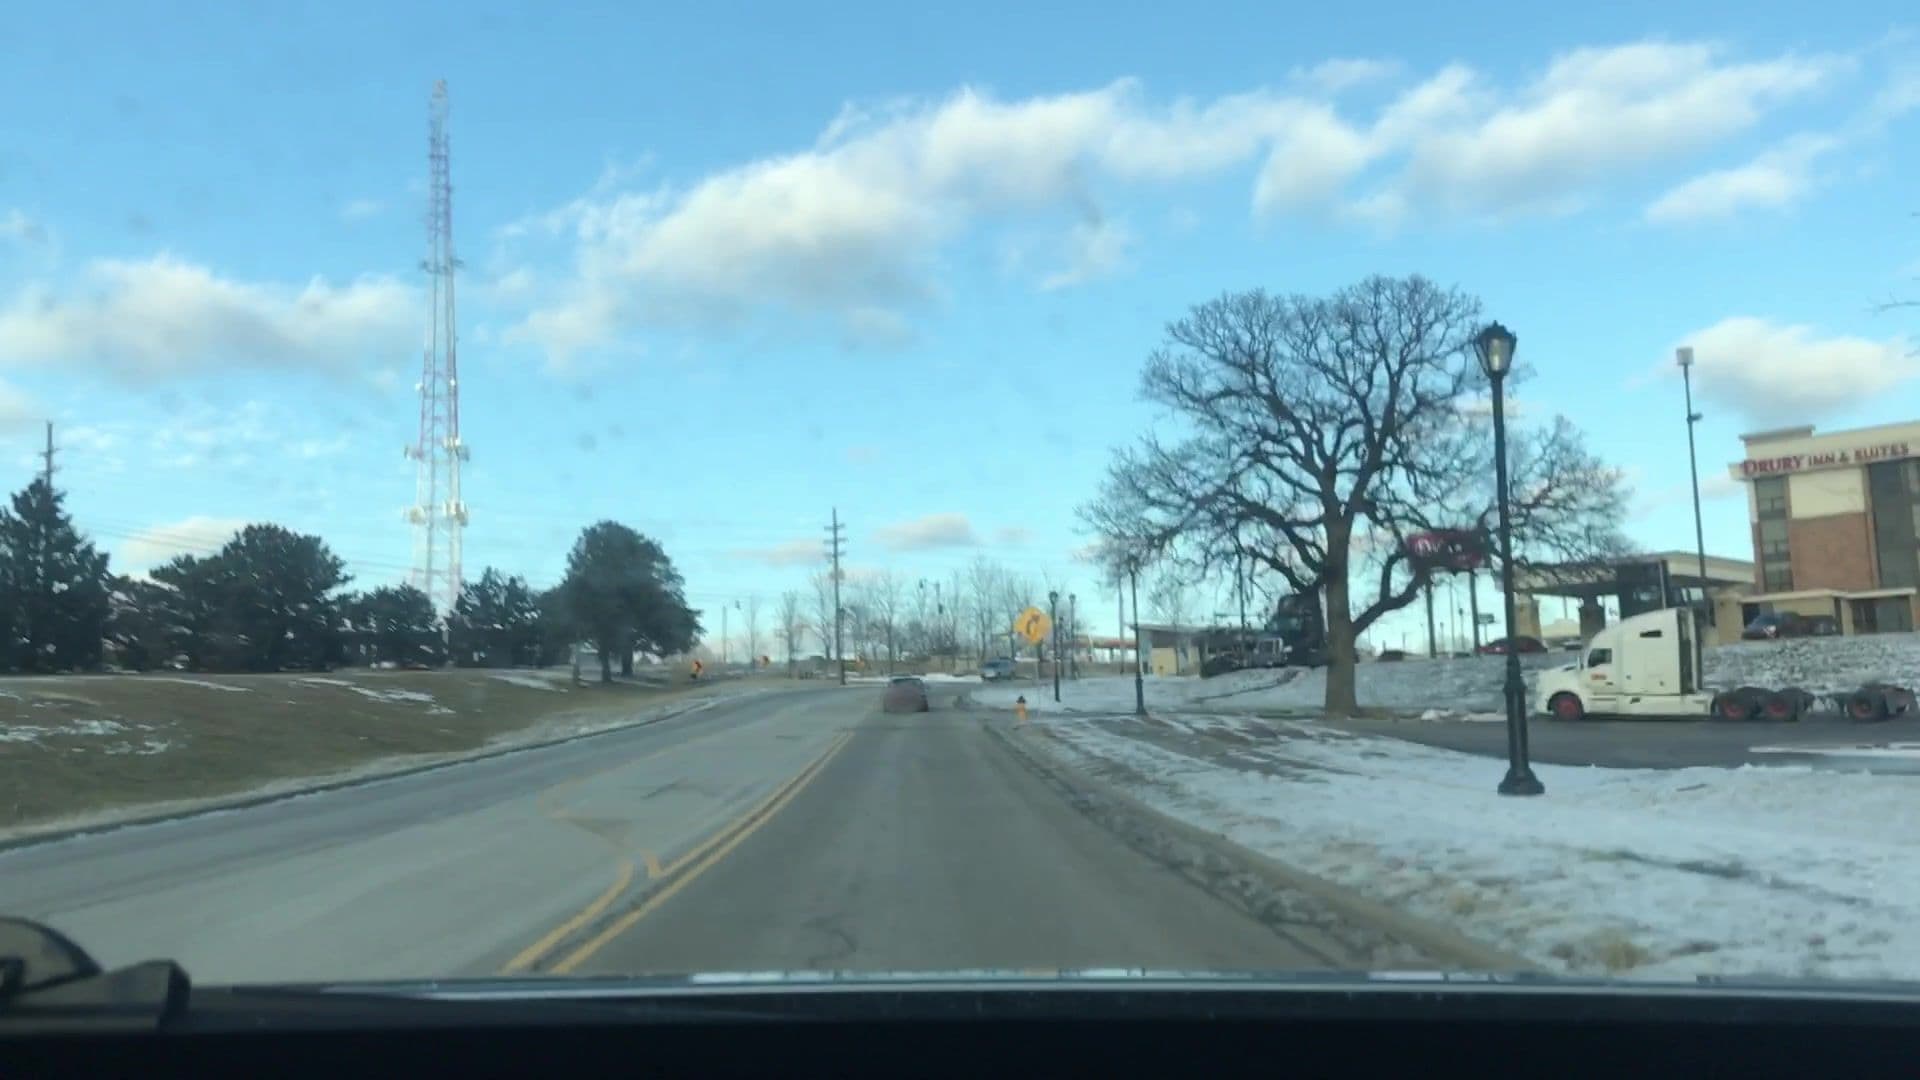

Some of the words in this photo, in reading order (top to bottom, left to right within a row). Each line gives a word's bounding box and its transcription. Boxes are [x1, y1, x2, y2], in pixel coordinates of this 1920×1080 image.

[1742, 455, 1804, 476] DRURY
[1808, 454, 1835, 466] INN
[1839, 451, 1849, 463] &
[1854, 442, 1909, 463] SUITES
